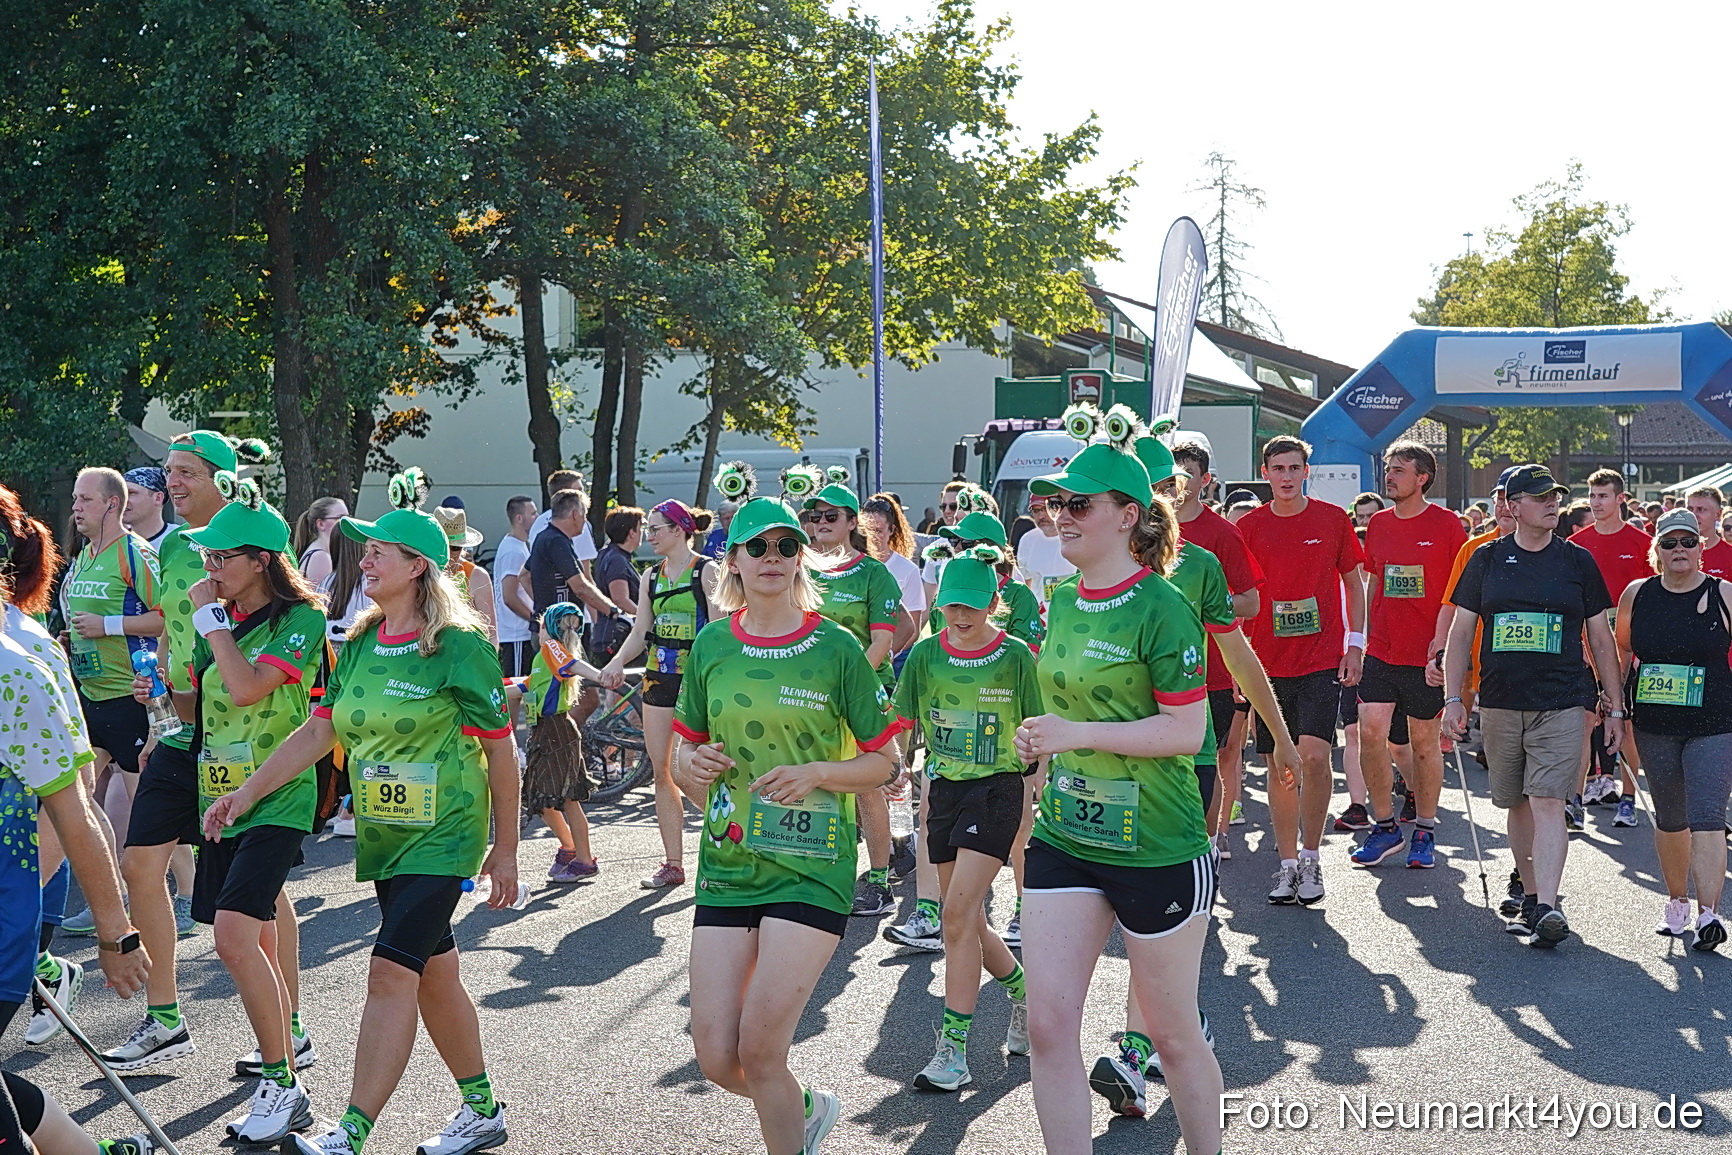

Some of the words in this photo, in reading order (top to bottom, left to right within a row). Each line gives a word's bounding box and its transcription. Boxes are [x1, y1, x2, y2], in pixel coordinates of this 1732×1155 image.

[1530, 363, 1621, 380] firmenlauf
[1356, 393, 1403, 405] Fischer
[1011, 457, 1050, 467] abavent
[1390, 576, 1417, 588] 1693
[1075, 588, 1137, 613] MONSTERSTARK
[1280, 611, 1312, 626] 1689
[661, 625, 679, 637] 627
[1505, 626, 1533, 639] 258
[373, 640, 420, 657] MONSTERSTA
[741, 634, 820, 659] MONSTERSTARK
[1087, 638, 1132, 657] TRENDHAUS
[948, 645, 1006, 668] MONSTERSTARK
[386, 679, 432, 695] TRENDHAUS
[980, 687, 1014, 697] TRENDHAUS
[1647, 677, 1674, 691] 294
[780, 685, 830, 703] TRENDHAUS
[778, 696, 825, 711] POWER-TEAM
[935, 726, 953, 744] 47
[965, 732, 973, 756] 2022
[944, 745, 963, 754] Sophie
[208, 766, 231, 784] 82
[380, 784, 407, 805] 98
[373, 804, 391, 813] Würz
[393, 806, 414, 815] Birgit
[1054, 798, 1062, 822] RUN
[1075, 798, 1105, 825] 32
[752, 811, 764, 836] RUN
[779, 809, 812, 833] 48
[1063, 818, 1092, 833] Deierler
[1094, 826, 1119, 838] Sarah
[1123, 809, 1133, 842] 2022
[761, 829, 794, 843] Stöcker
[796, 834, 827, 846] Sandra
[827, 817, 837, 849] 2022
